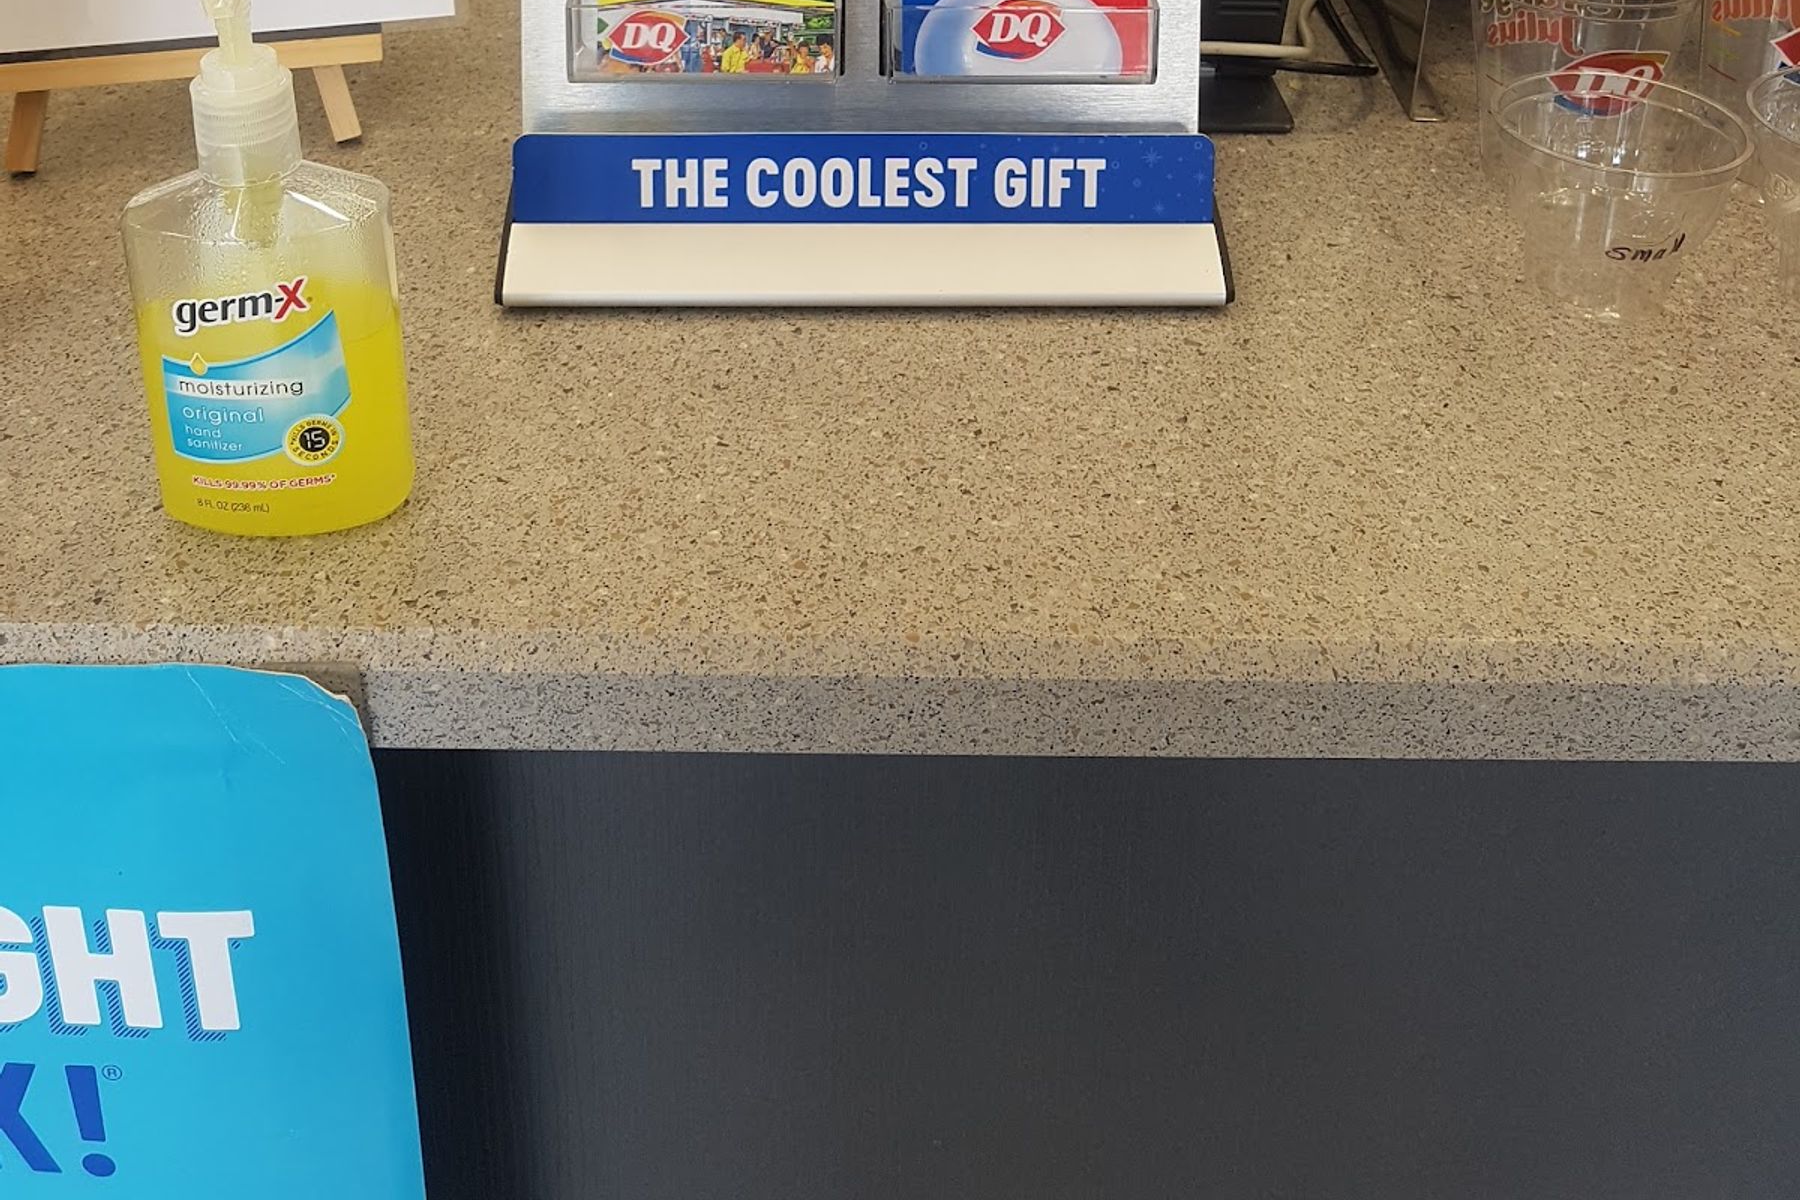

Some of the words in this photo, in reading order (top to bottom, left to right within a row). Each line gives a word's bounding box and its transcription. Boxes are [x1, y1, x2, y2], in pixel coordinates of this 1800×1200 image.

[621, 22, 677, 53] DQ
[987, 12, 1051, 48] DQ
[631, 157, 729, 209] THE
[745, 157, 978, 209] COOLEST
[993, 157, 1107, 210] GIFT
[178, 380, 304, 396] moisturizing
[182, 406, 264, 425] original
[185, 424, 222, 438] hand
[303, 430, 326, 449] 15
[187, 436, 243, 451] sanitizer
[193, 475, 223, 487] KILLS
[225, 480, 267, 489] 99.99%
[270, 480, 287, 488] OF
[216, 501, 229, 511] OZ
